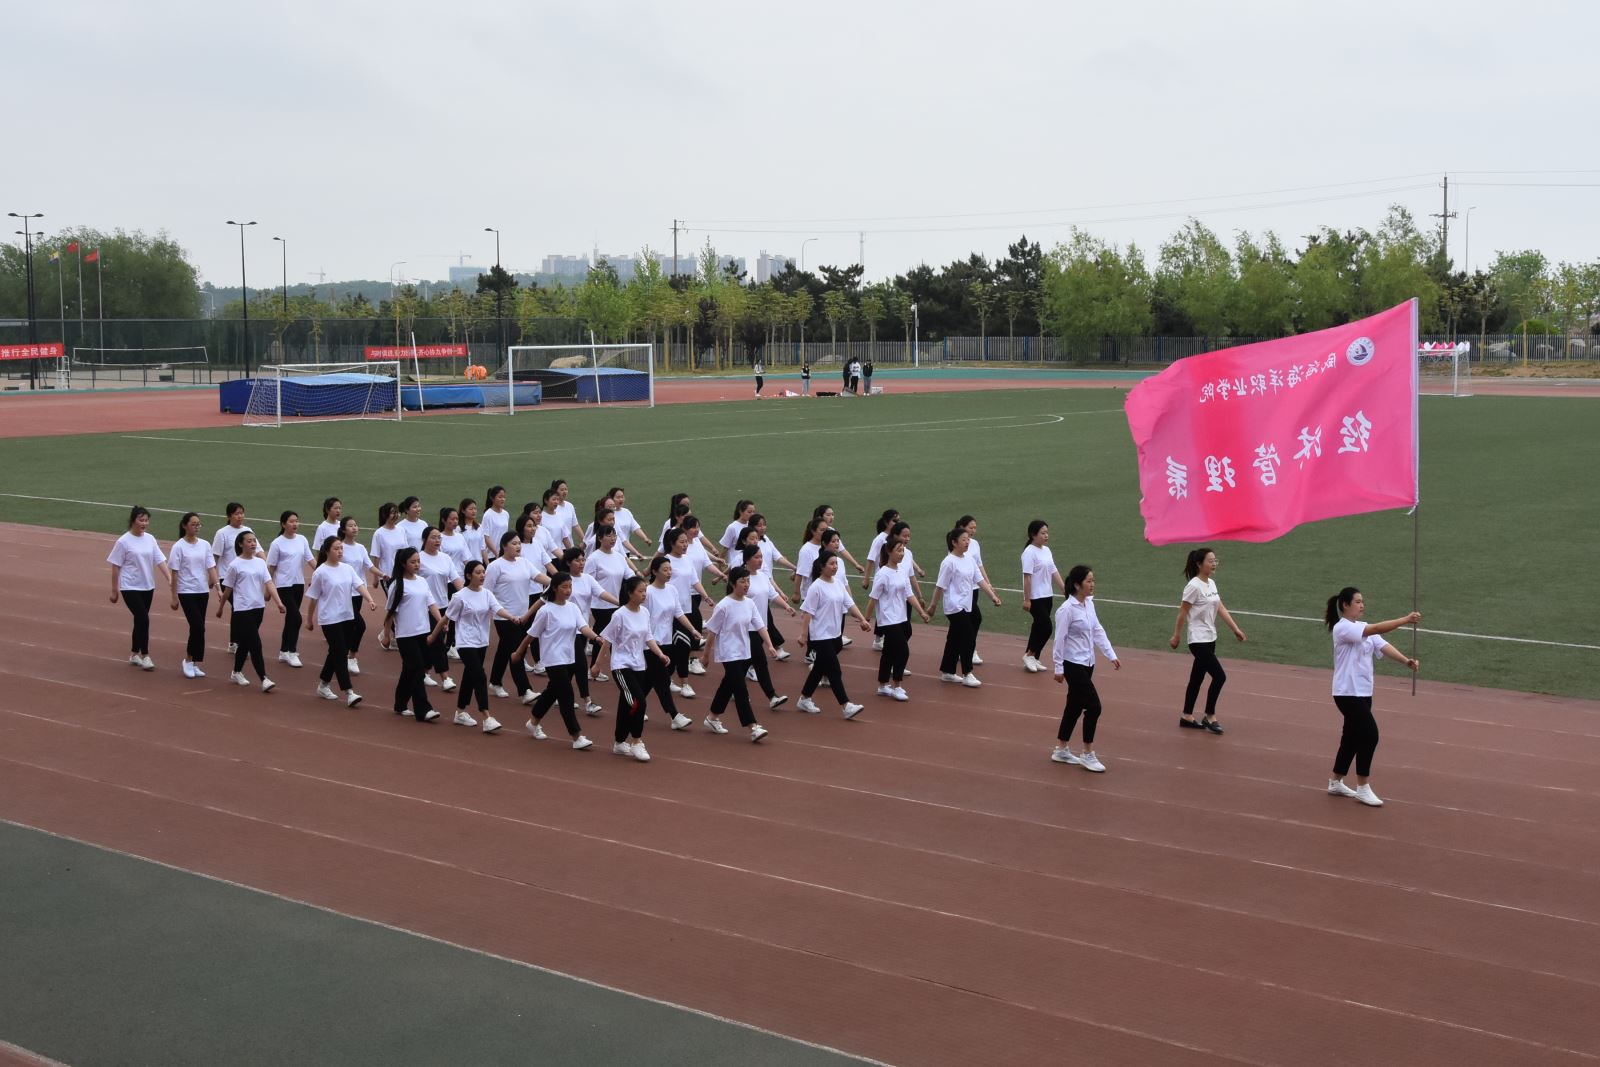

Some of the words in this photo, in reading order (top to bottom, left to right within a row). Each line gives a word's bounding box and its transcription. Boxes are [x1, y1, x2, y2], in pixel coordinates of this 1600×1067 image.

[1, 346, 57, 357] 推行全民健身
